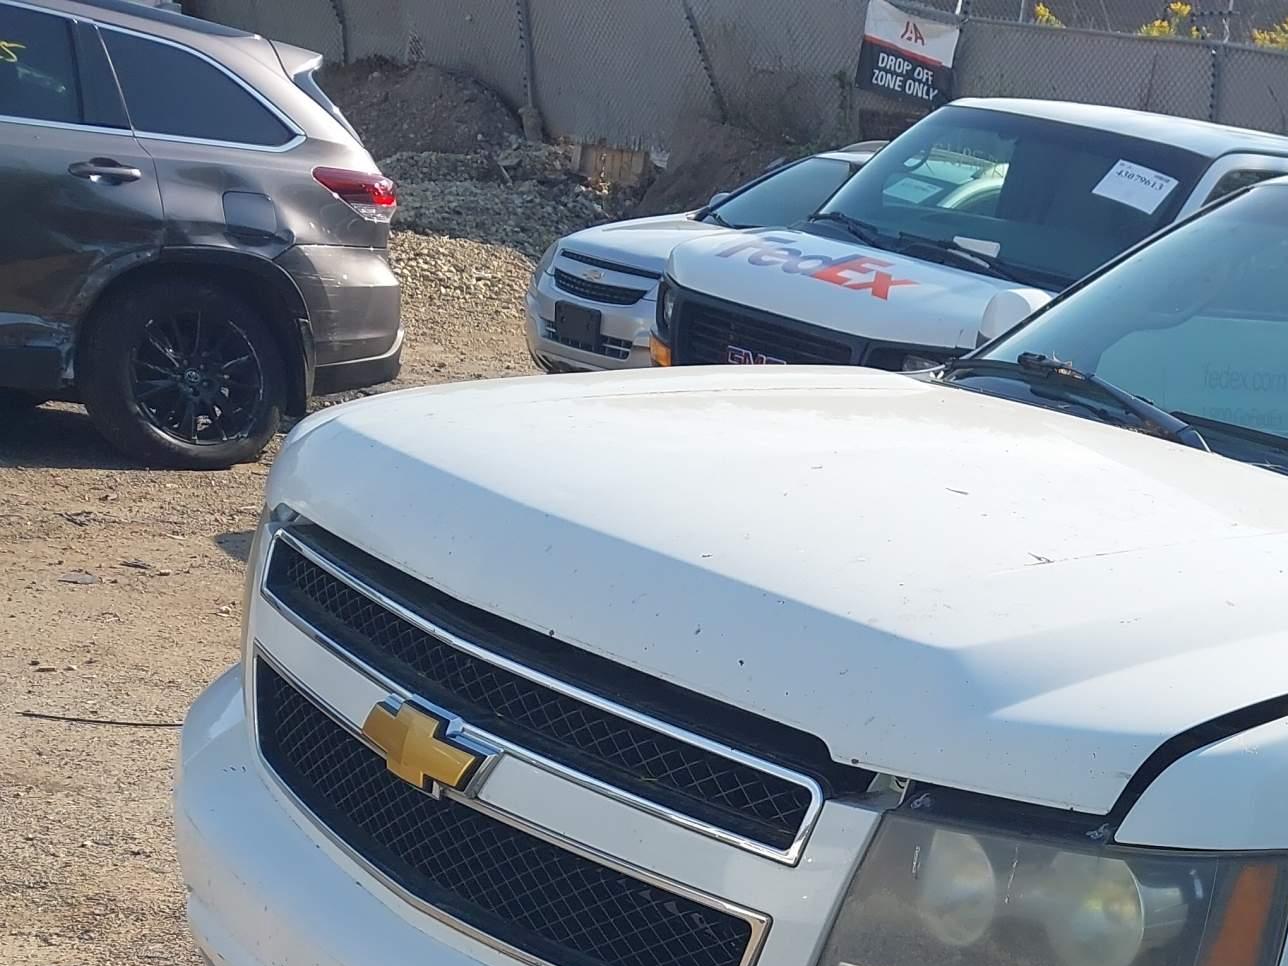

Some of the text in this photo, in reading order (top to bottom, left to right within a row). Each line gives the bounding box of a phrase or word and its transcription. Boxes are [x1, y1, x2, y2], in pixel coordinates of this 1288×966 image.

[872, 69, 938, 101] ZONE ONLY
[878, 52, 933, 85] DROP OFF
[714, 235, 920, 301] FedEx
